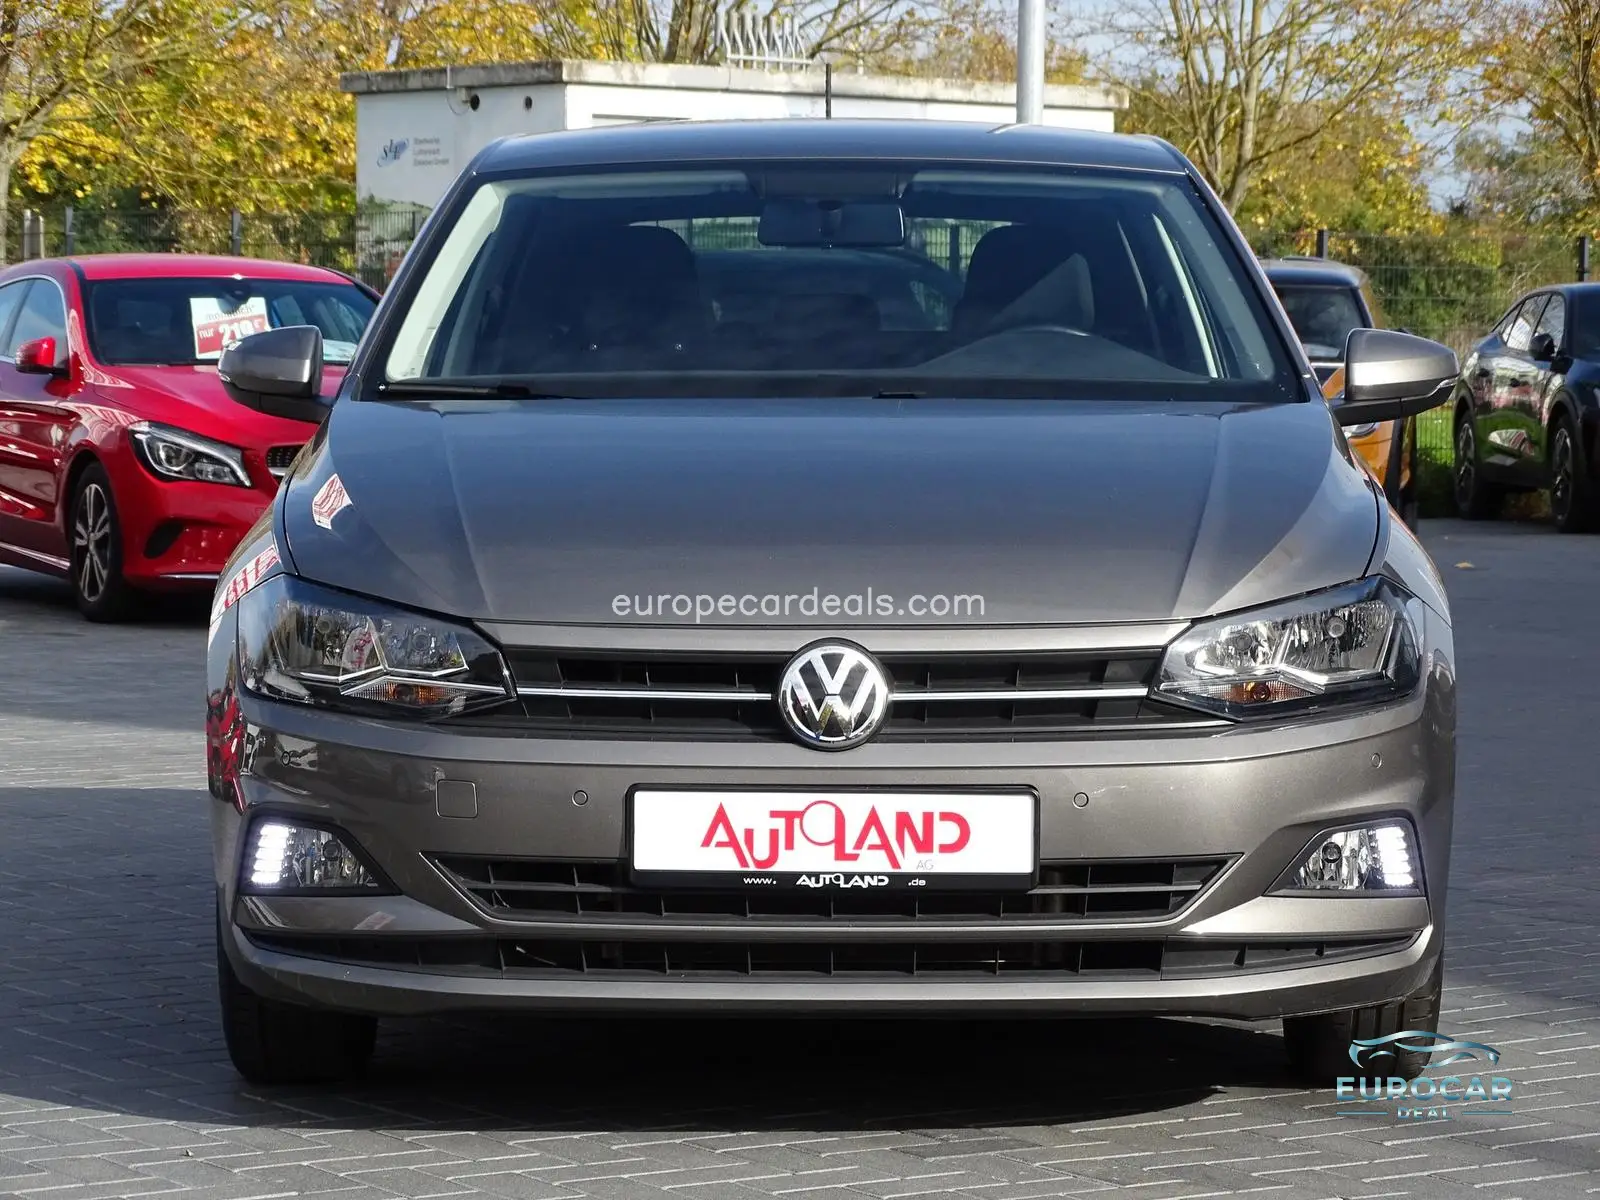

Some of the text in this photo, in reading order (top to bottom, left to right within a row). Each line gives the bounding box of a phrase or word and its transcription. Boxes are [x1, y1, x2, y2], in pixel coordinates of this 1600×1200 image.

[199, 328, 215, 339] nur
[784, 643, 884, 741] VW
[700, 799, 971, 869] AUTOLAND
[916, 859, 934, 871] AG
[743, 877, 777, 885] www.
[908, 878, 926, 887] .de
